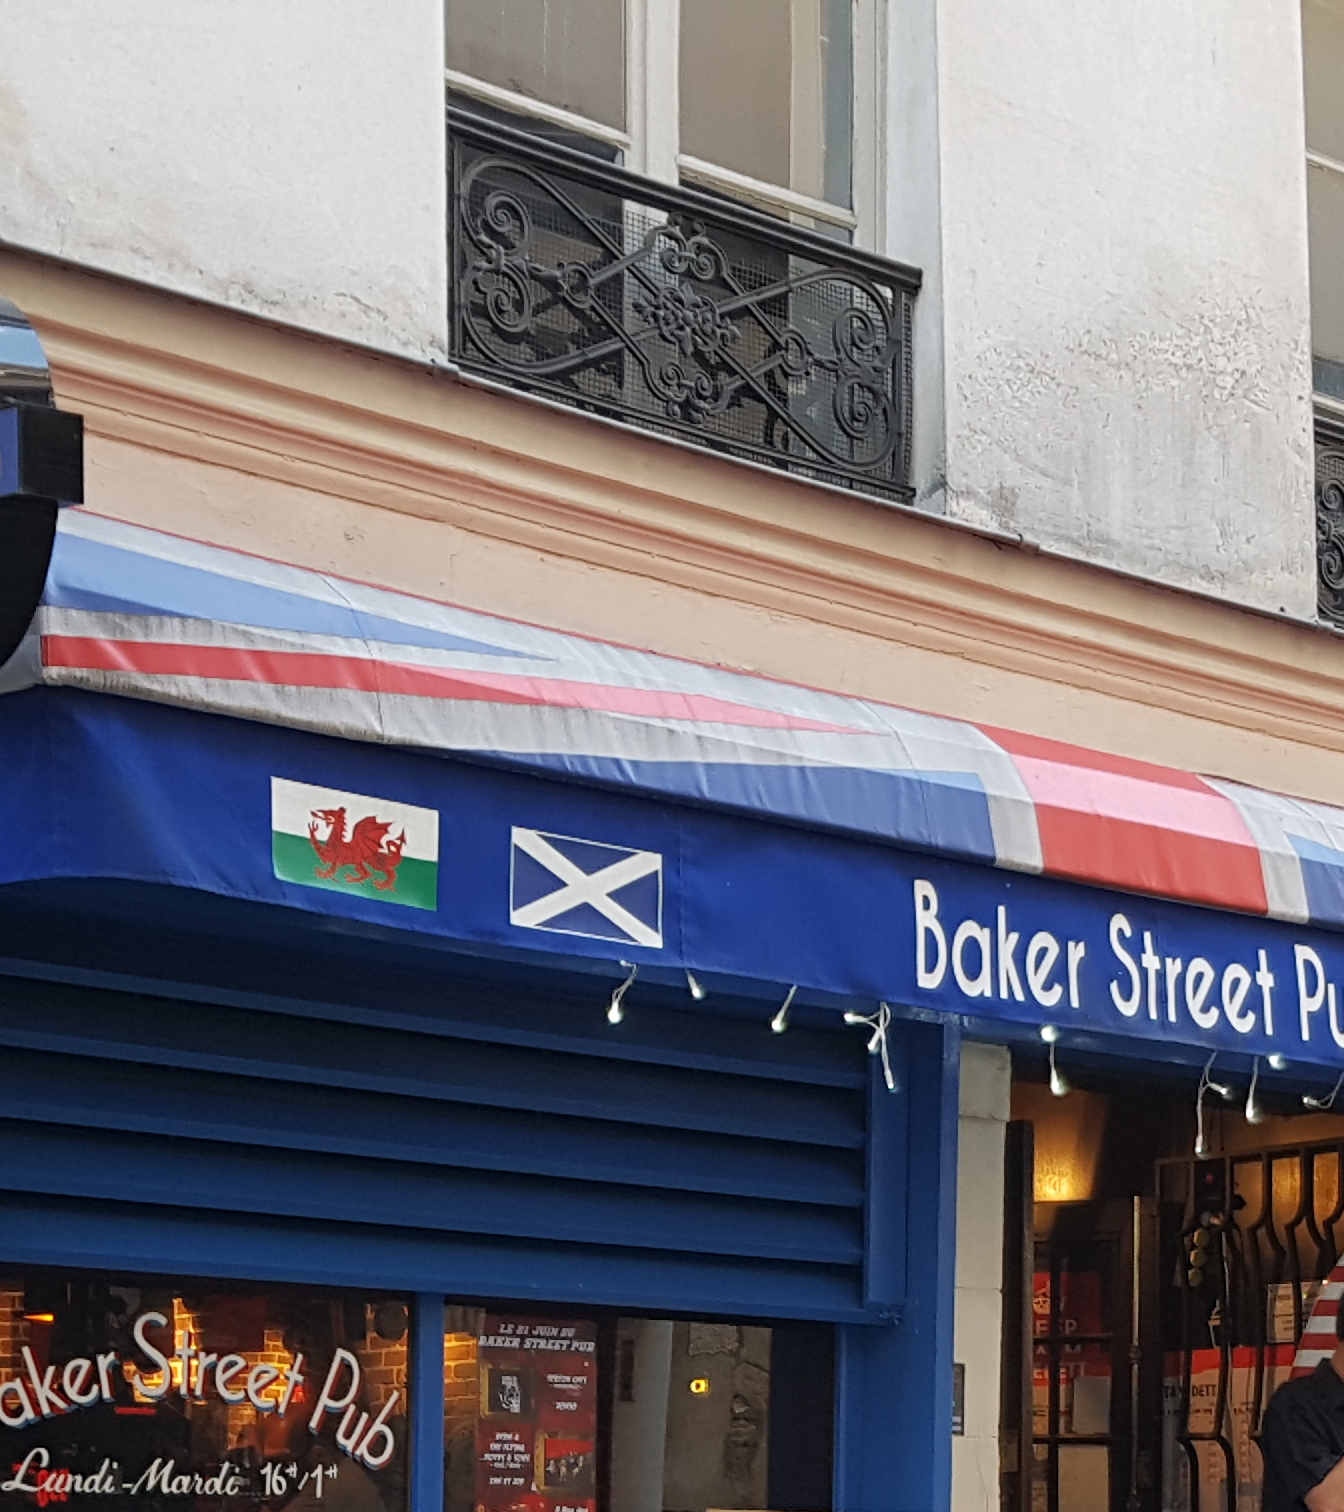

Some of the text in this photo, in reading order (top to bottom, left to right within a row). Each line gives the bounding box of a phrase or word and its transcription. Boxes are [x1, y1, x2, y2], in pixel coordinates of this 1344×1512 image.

[913, 878, 1085, 1009] Baker
[1109, 913, 1274, 1036] Street
[133, 1311, 304, 1418] Street
[309, 1348, 399, 1470] Pub
[523, 1338, 570, 1350] STREET
